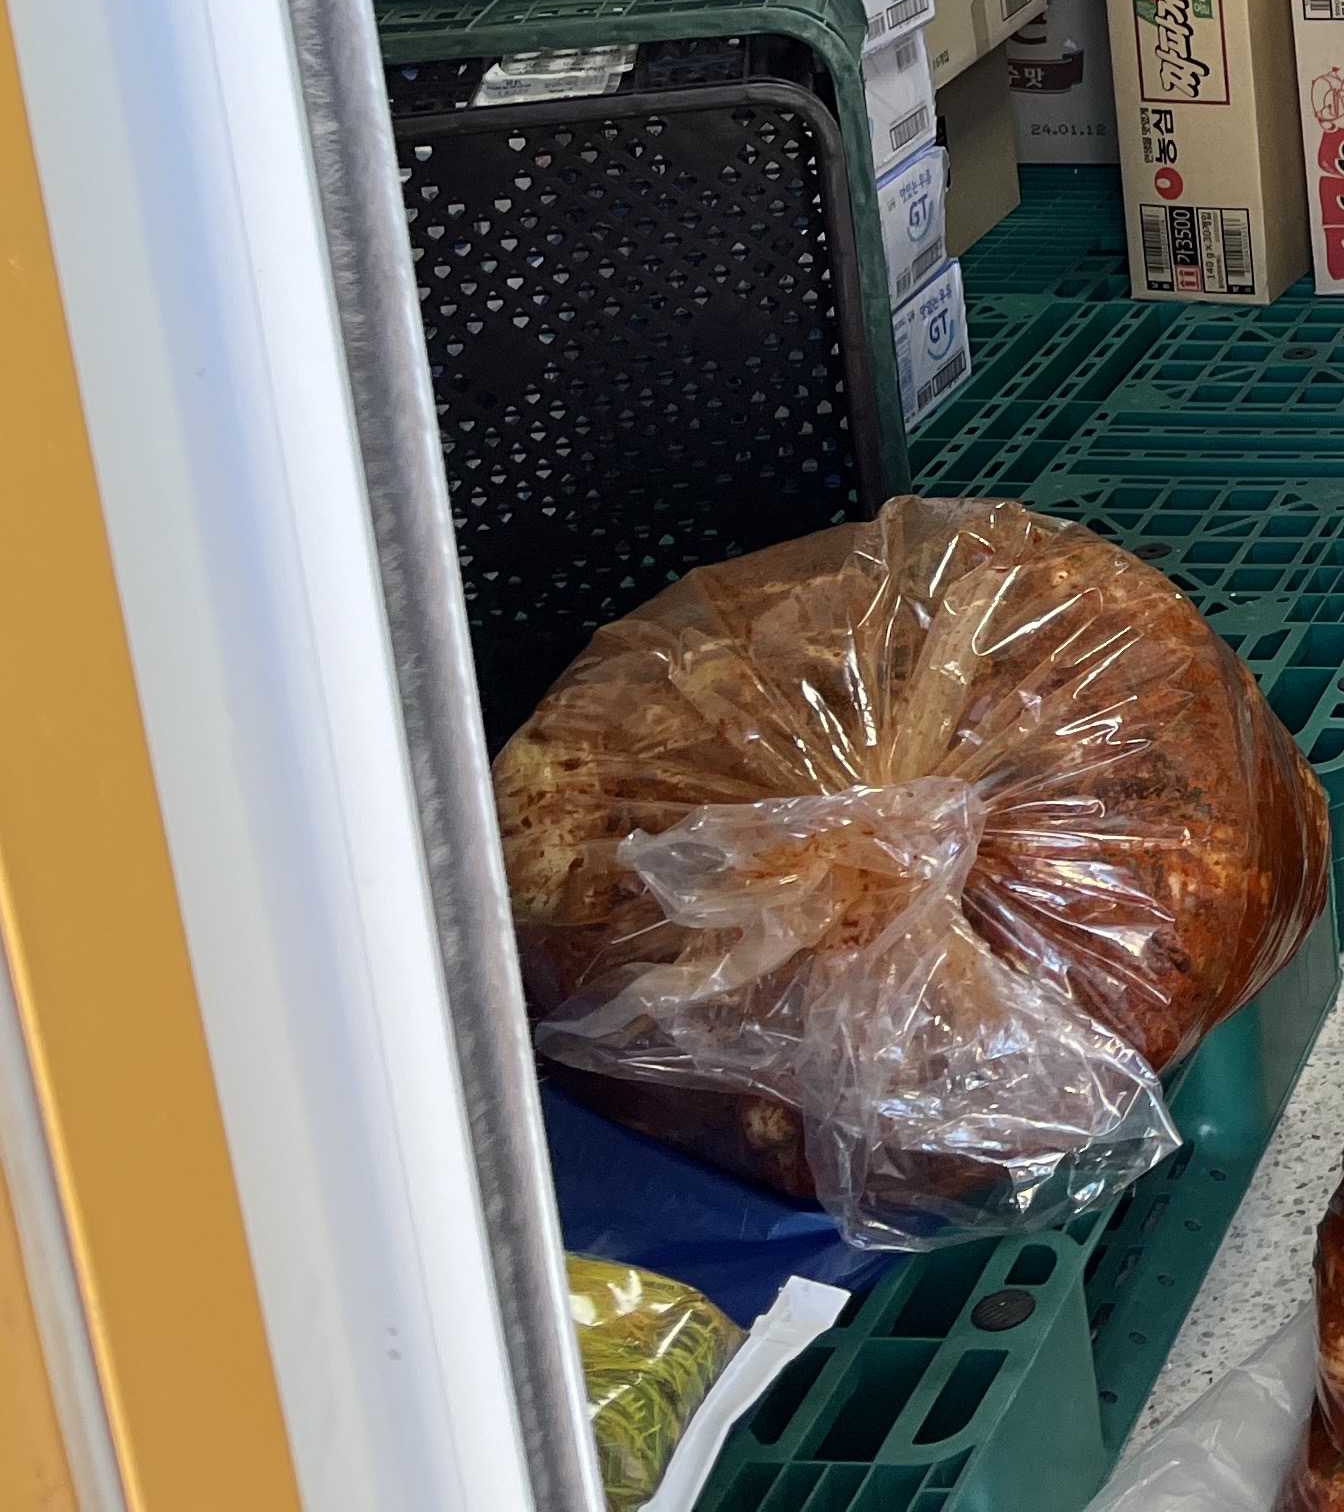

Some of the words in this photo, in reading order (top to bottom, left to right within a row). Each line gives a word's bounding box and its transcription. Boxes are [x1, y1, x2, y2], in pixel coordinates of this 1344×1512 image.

[1152, 109, 1178, 164] 농심
[909, 194, 928, 227] GT
[1173, 209, 1191, 265] 가3500
[929, 308, 949, 343] GT
